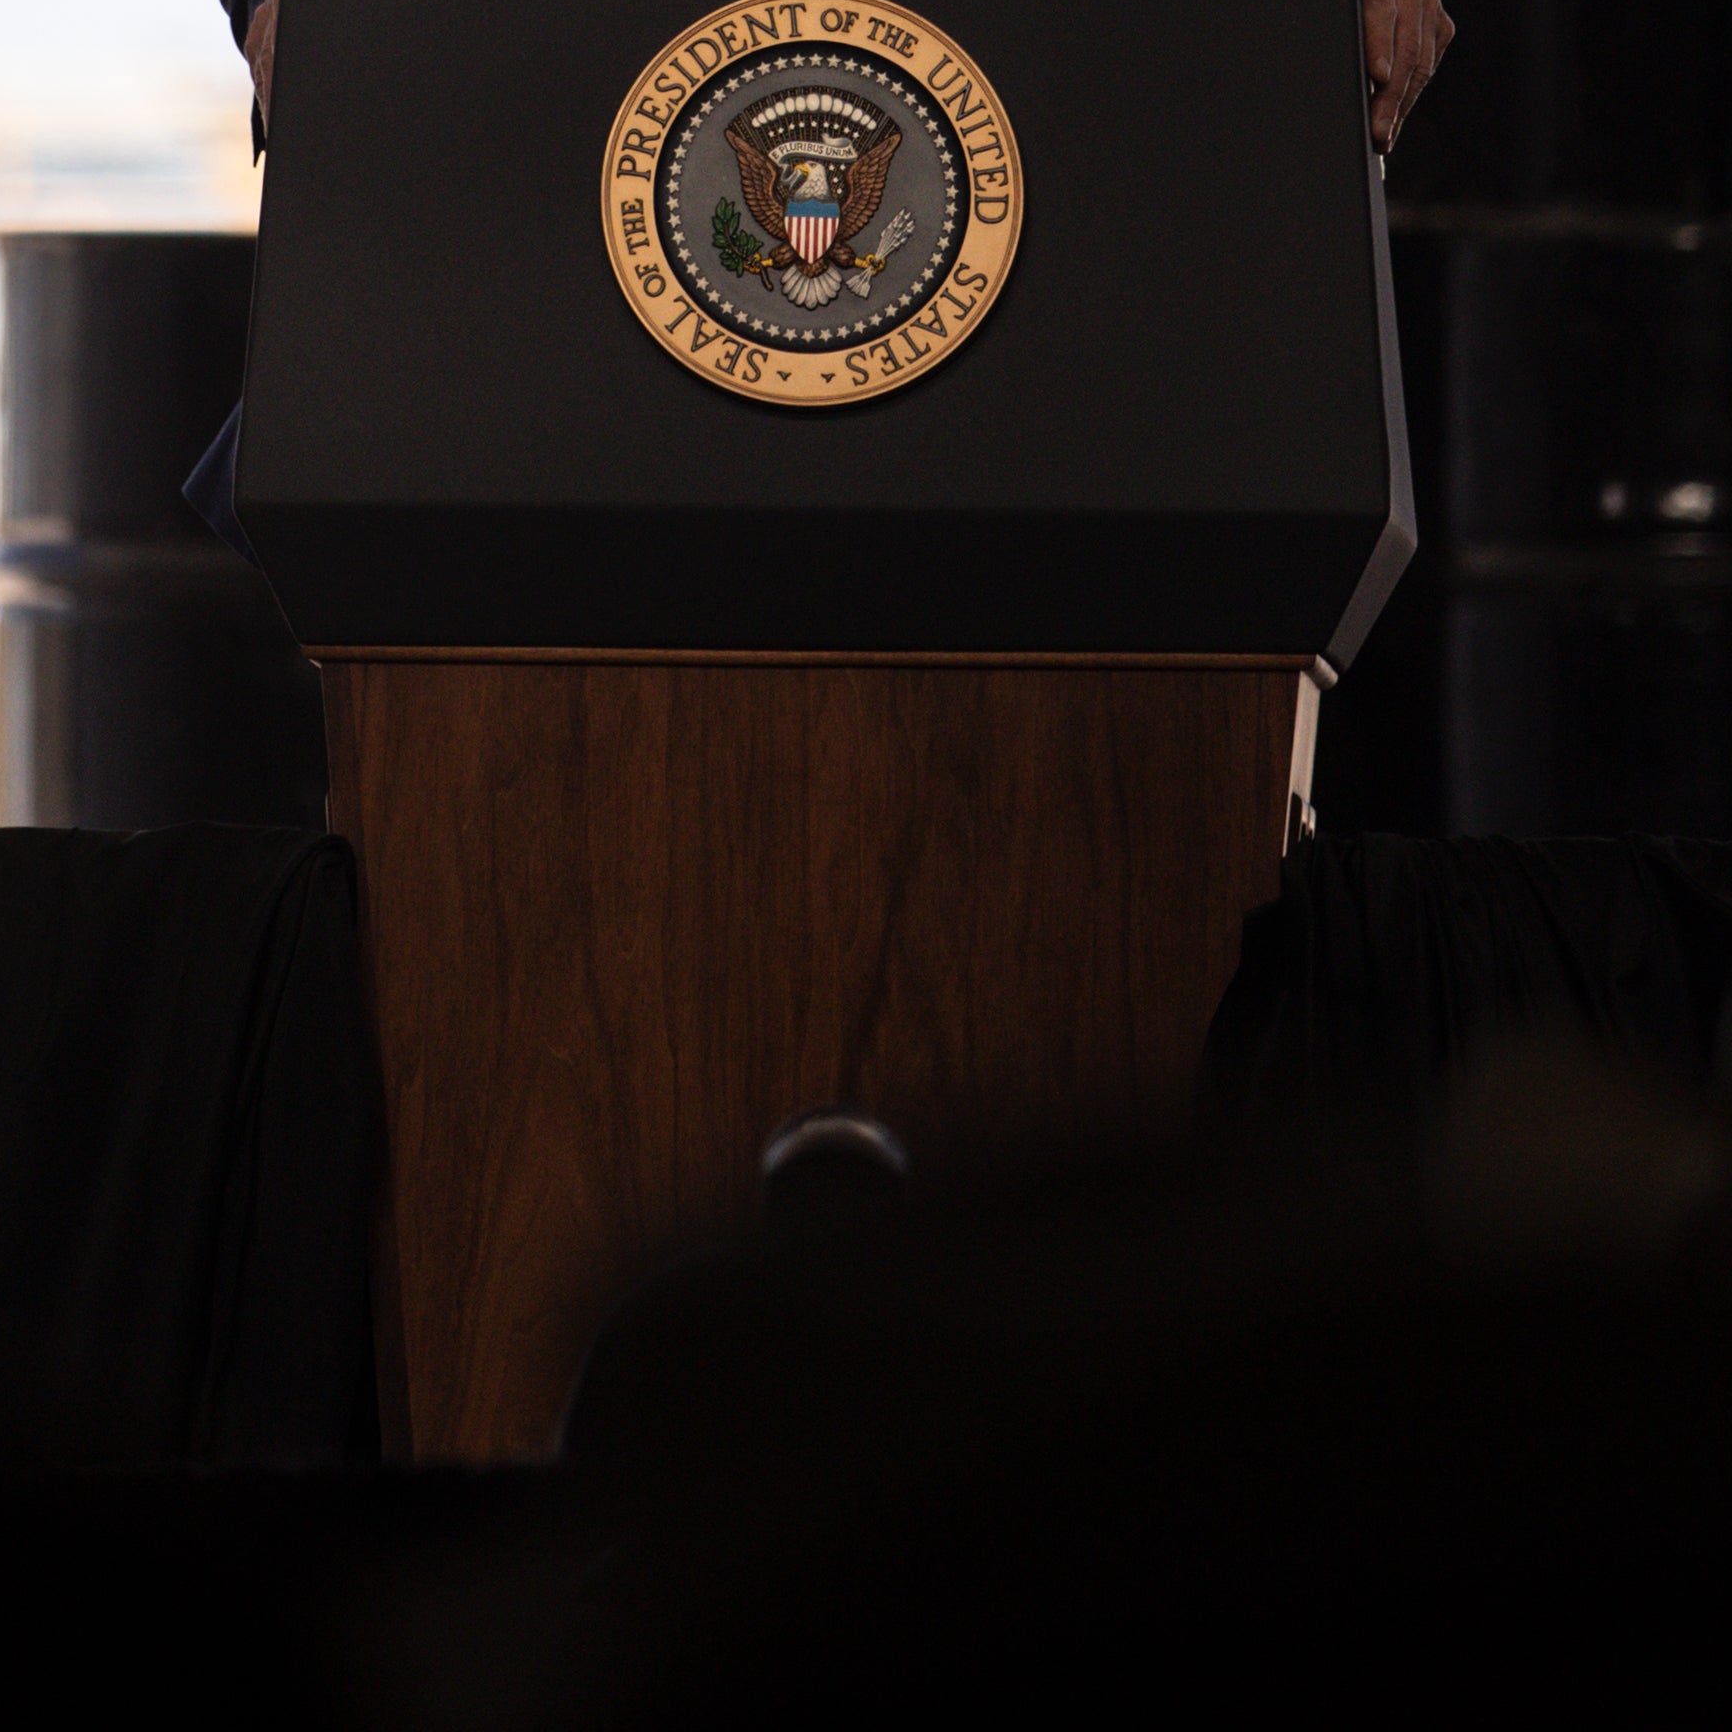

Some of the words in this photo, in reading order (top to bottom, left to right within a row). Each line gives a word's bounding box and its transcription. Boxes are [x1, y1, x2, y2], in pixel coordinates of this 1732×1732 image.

[820, 8, 859, 33] OF
[868, 16, 919, 58] THE
[617, 2, 807, 182] PRESIDENT
[779, 142, 824, 155] PLURIBUS
[826, 147, 854, 157] UNUM
[927, 53, 1009, 224] UNITED
[620, 198, 650, 256] THE
[634, 263, 667, 298] OF
[664, 295, 769, 383] SEAL
[845, 262, 989, 387] STATES
